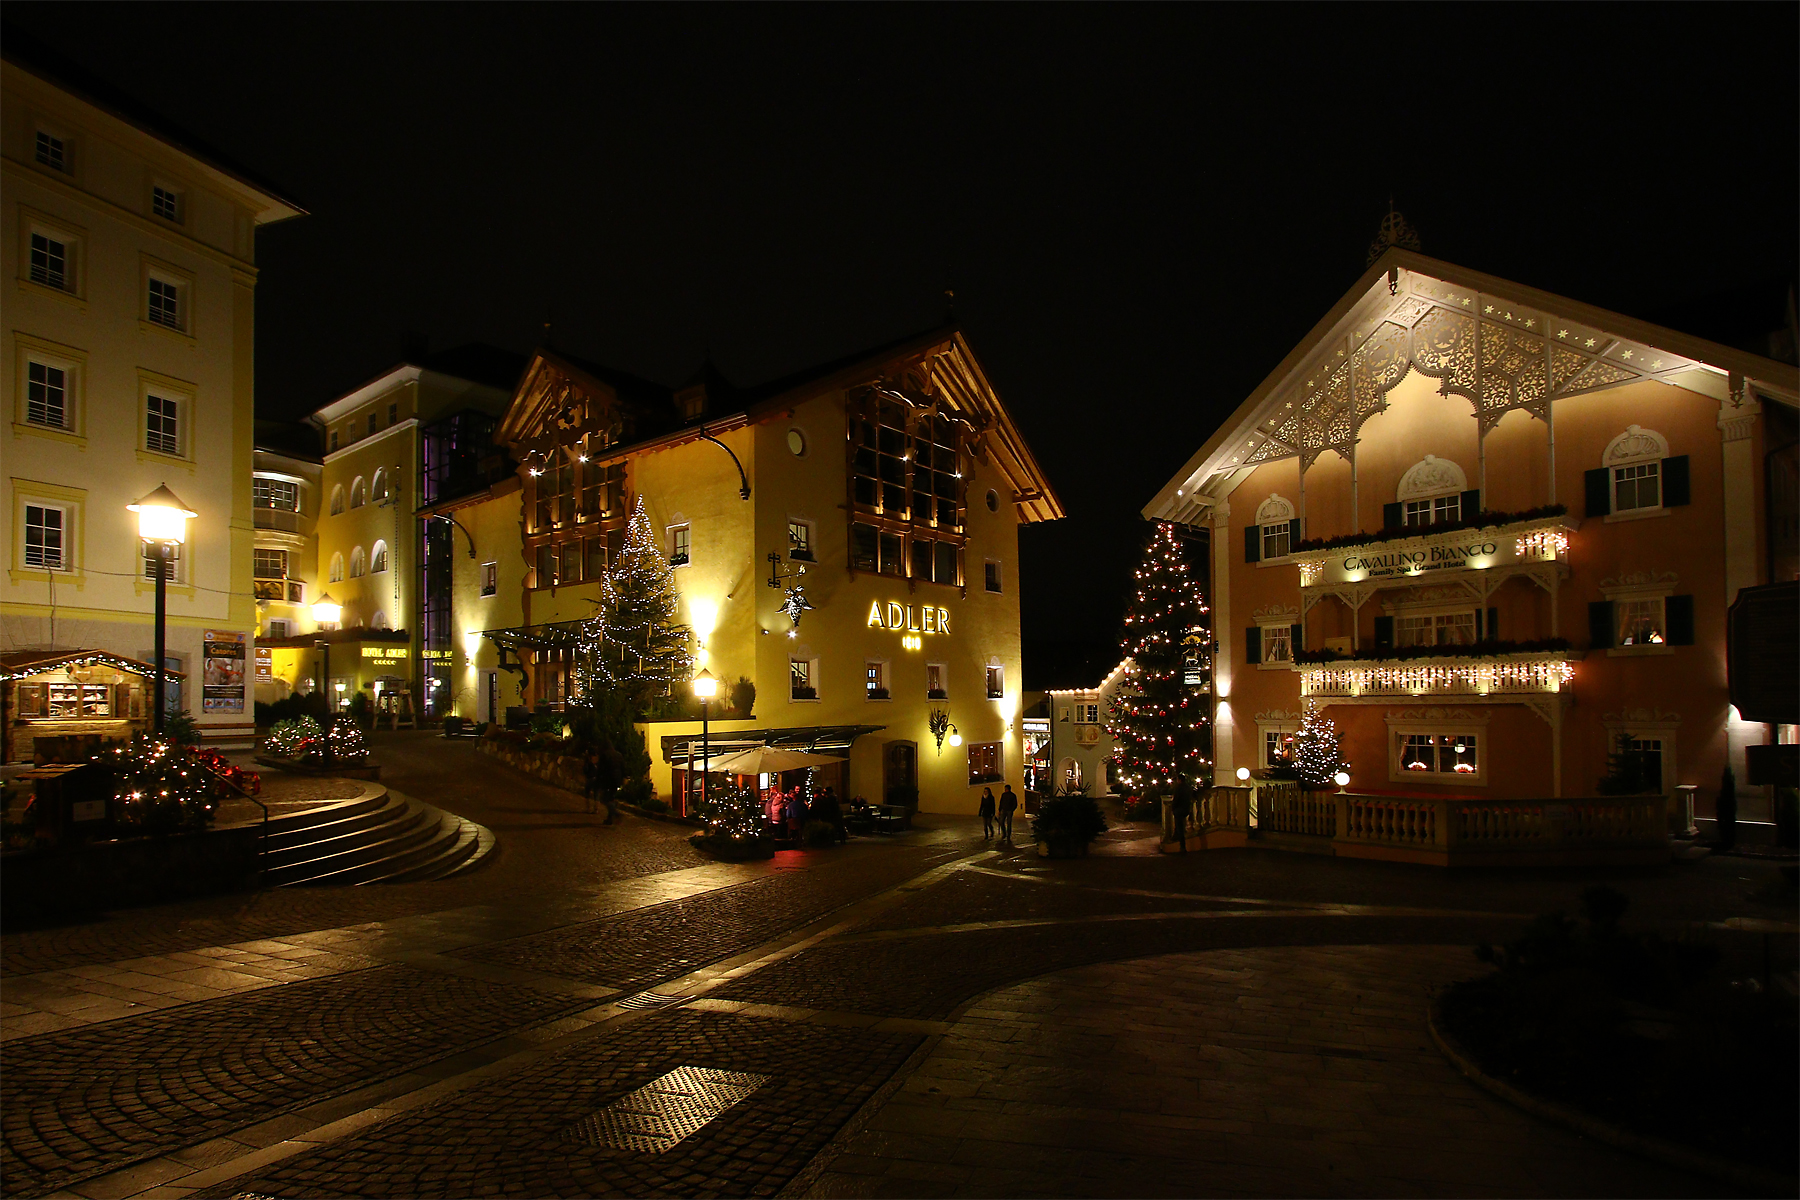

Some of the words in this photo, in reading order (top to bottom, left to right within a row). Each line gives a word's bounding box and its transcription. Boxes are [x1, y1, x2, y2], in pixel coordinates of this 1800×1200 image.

[1368, 567, 1395, 577] Family
[1396, 566, 1412, 575] Spa
[1414, 562, 1442, 572] Grand
[1443, 559, 1467, 569] Hotel
[867, 600, 951, 635] ADLER
